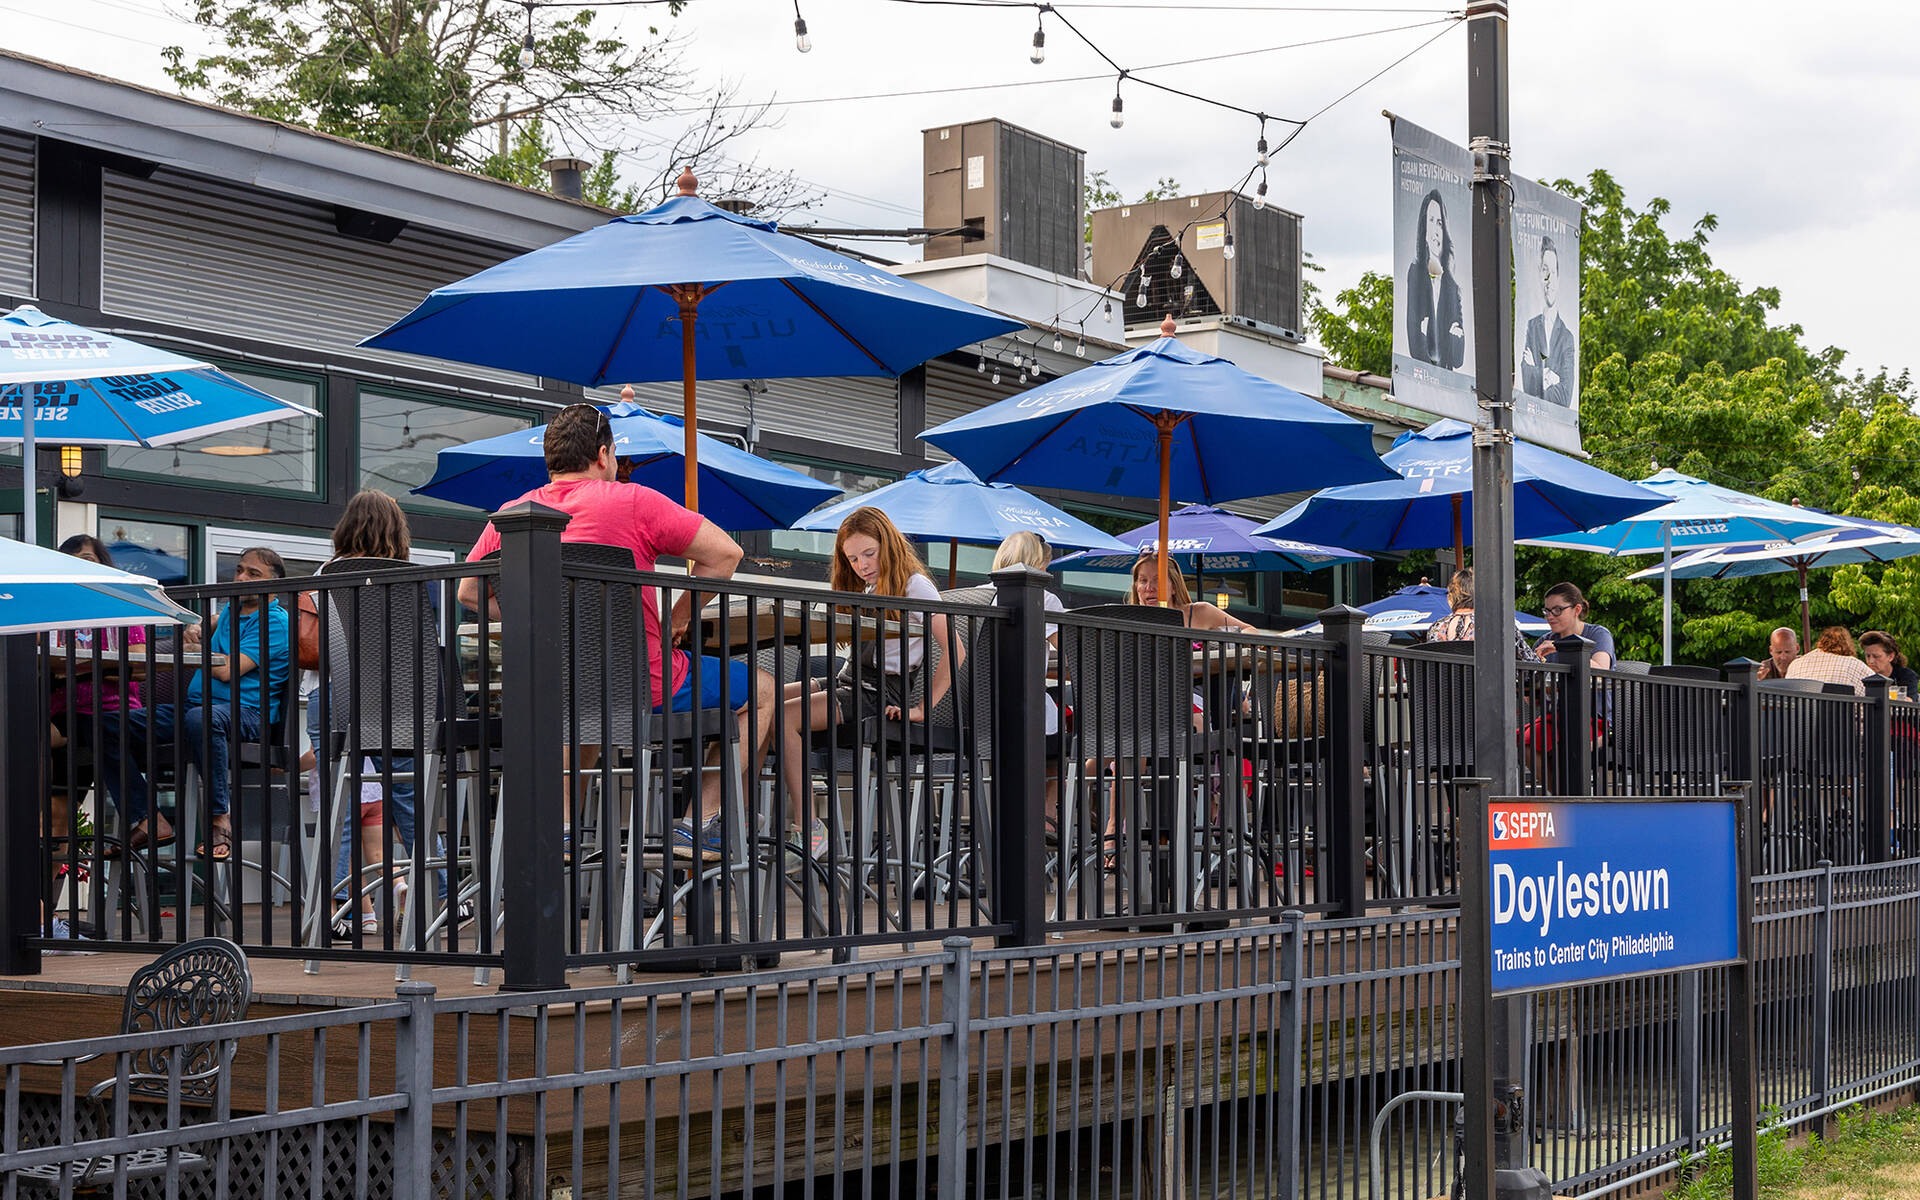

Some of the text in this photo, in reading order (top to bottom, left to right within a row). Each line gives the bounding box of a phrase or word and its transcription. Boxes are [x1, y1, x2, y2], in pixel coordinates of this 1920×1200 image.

[1419, 163, 1465, 185] REVISIONIST
[1527, 213, 1566, 235] FUNCTION
[0, 340, 112, 349] LIGHT
[11, 332, 94, 342] BUD
[13, 347, 111, 360] SELTZER
[997, 510, 1071, 528] ULTRA
[1194, 561, 1250, 569] IGHT
[1510, 811, 1556, 839] SEPTA
[1493, 860, 1669, 937] Doylestown
[1494, 931, 1675, 972] Trains to Center City Philadelphia
